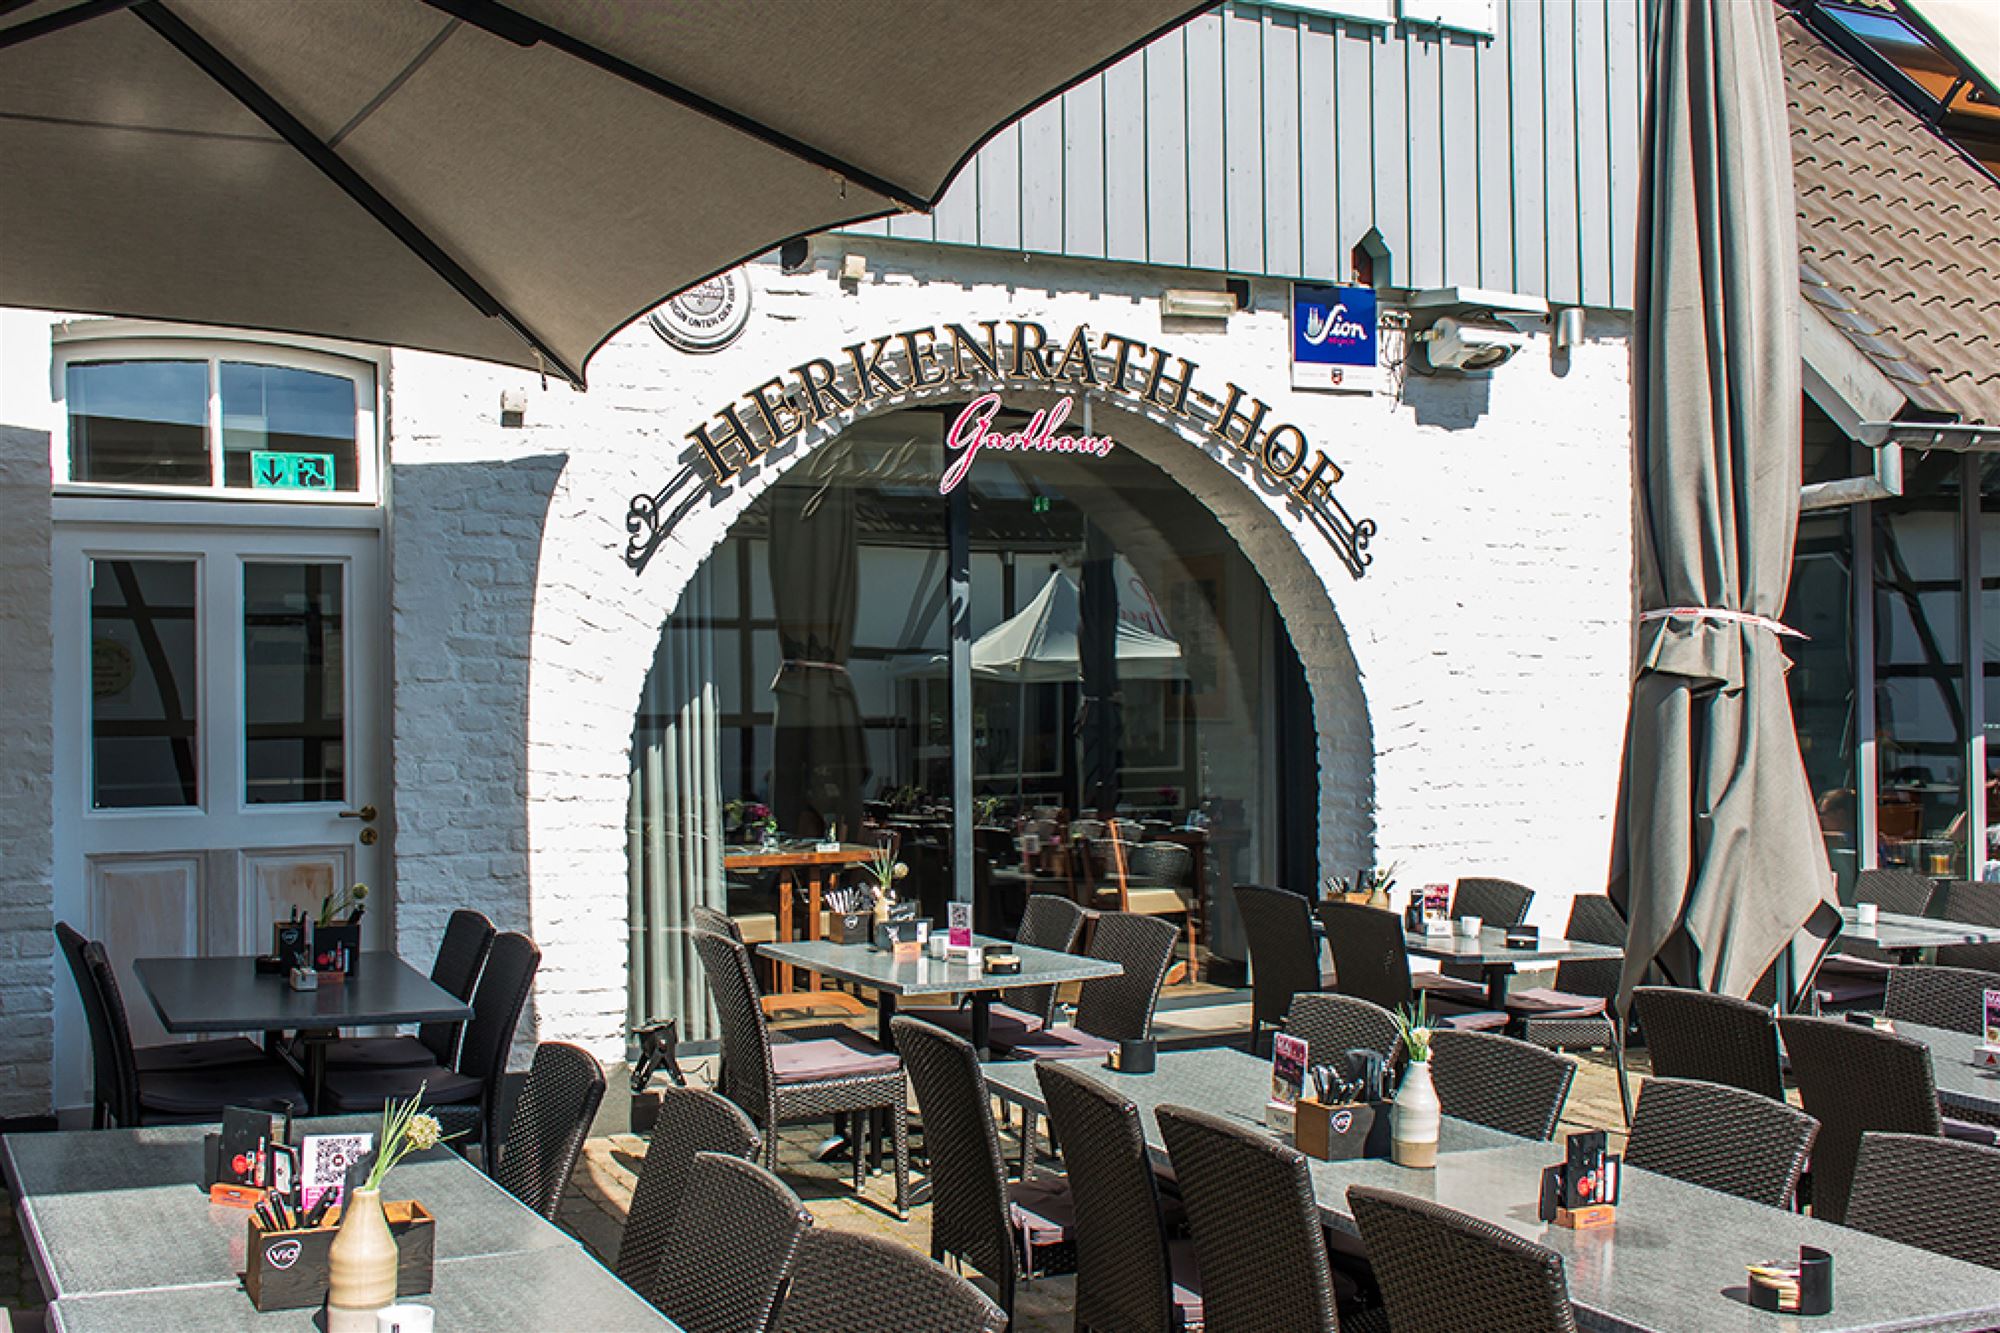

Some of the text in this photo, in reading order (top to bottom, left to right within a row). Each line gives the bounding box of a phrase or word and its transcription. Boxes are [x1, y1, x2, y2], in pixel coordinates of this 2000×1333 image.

[1303, 303, 1368, 345] Sion
[684, 319, 1345, 505] HERKENRATH-HOF
[939, 392, 1115, 495] Gasthaus
